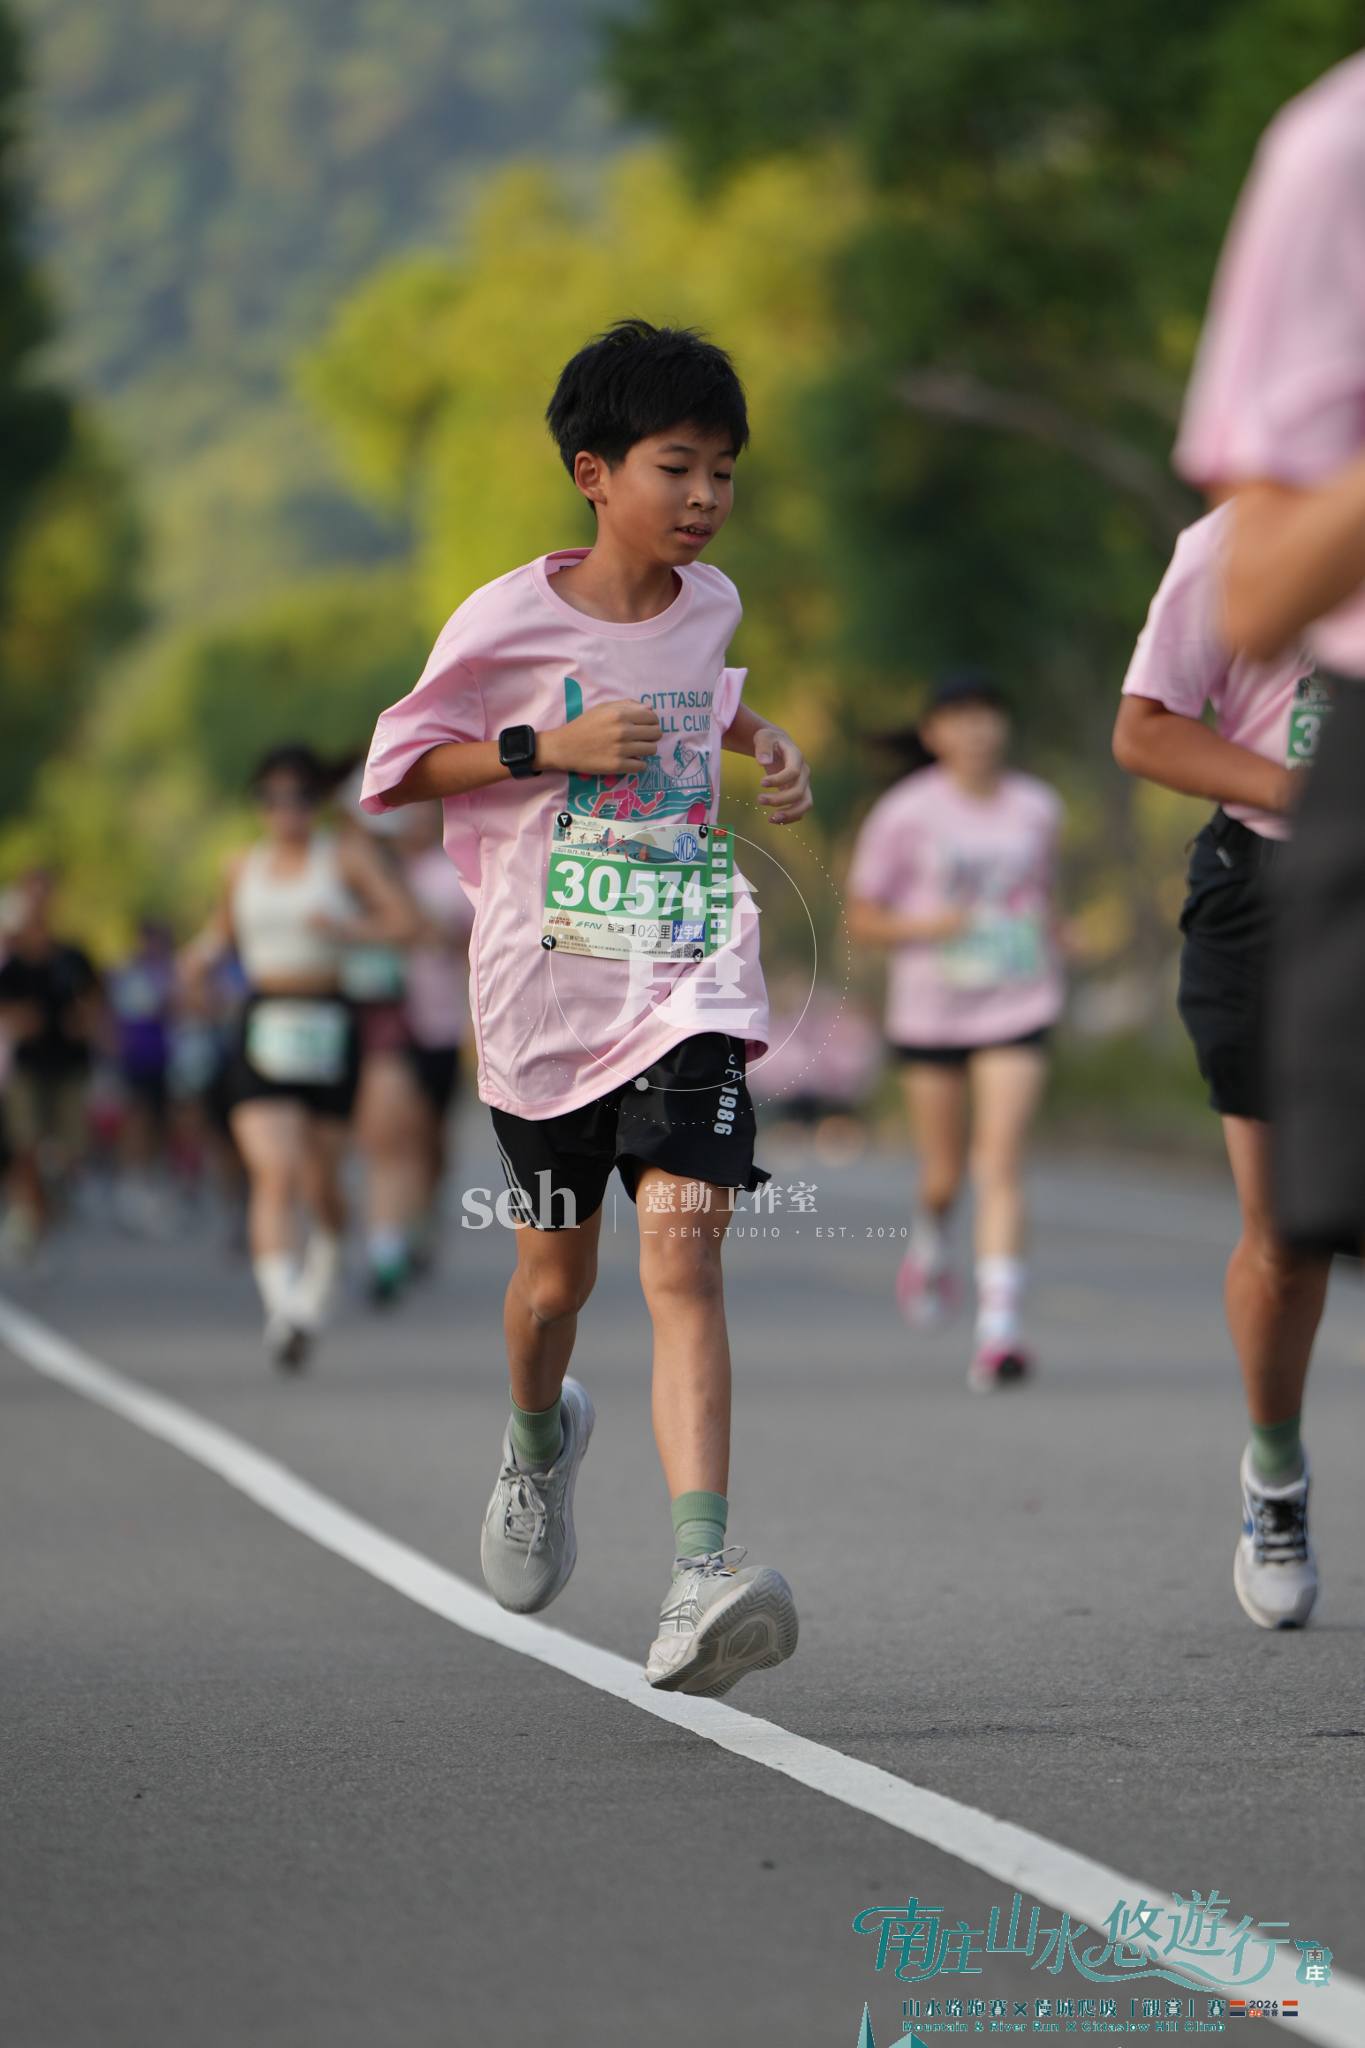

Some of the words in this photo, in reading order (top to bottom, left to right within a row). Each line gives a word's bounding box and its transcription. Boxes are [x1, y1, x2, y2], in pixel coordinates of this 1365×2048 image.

[660, 716, 679, 733] LL
[552, 860, 703, 916] 30574
[713, 1086, 739, 1136] 1986
